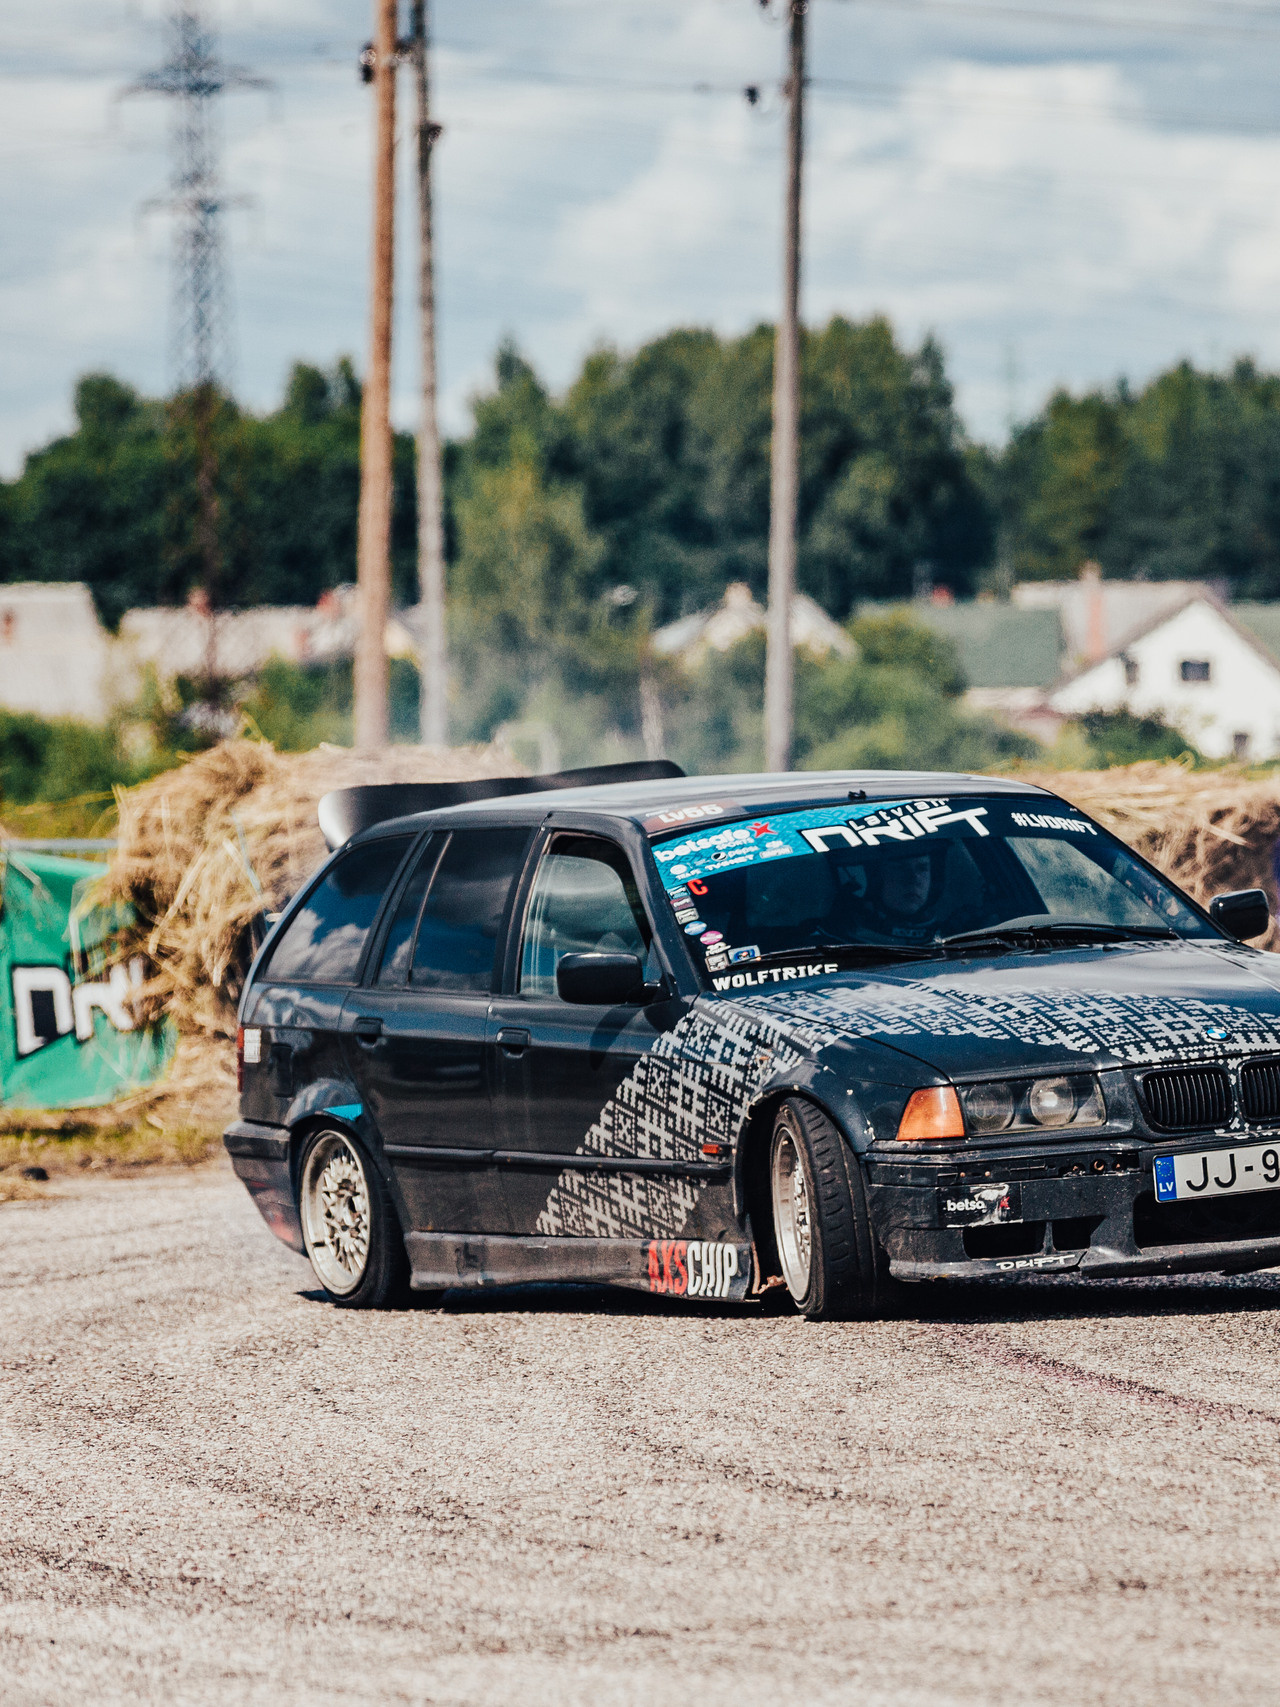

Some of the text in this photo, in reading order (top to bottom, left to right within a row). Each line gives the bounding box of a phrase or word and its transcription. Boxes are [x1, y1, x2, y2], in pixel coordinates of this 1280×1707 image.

[848, 798, 950, 832] Latvian
[1011, 812, 1098, 836] #LVDRIFT
[801, 806, 990, 853] DRIFT
[712, 963, 839, 992] WOLFTRIKE
[1158, 1181, 1175, 1194] LV
[946, 1199, 987, 1213] betsa
[995, 1253, 1076, 1271] DRIFT
